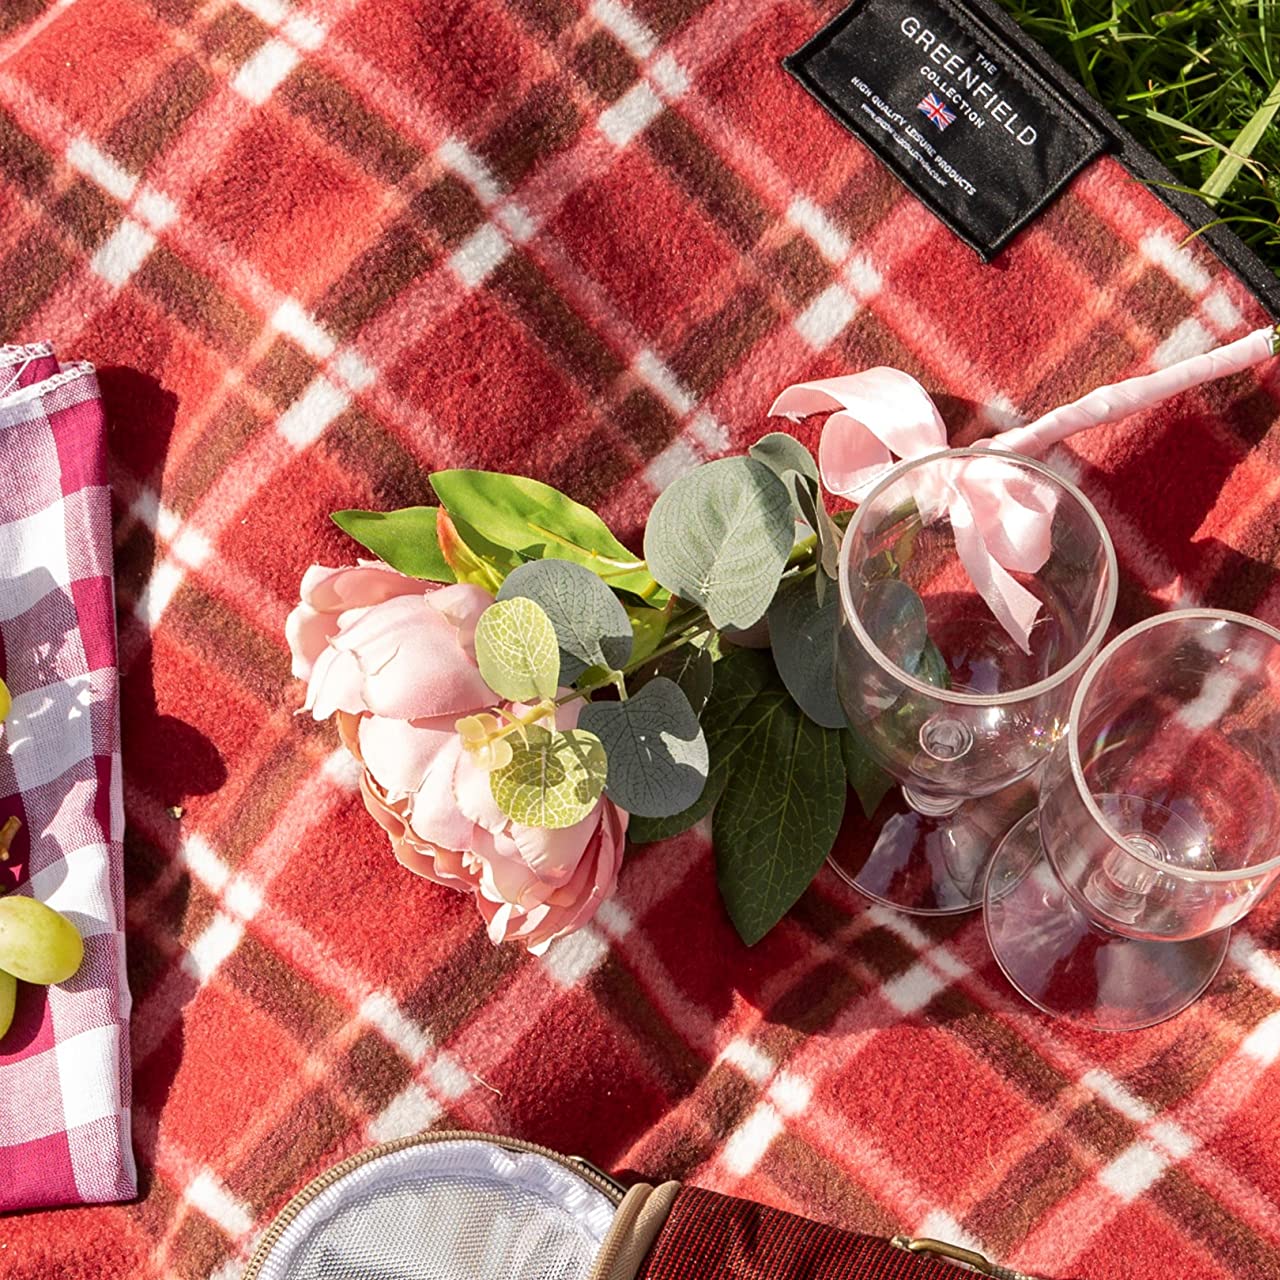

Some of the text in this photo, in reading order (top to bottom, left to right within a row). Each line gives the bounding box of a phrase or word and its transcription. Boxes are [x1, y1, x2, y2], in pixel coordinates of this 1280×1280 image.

[900, 16, 1038, 147] GREENFIELD
[920, 65, 986, 130] COLLECTION
[975, 53, 998, 75] THE
[850, 76, 977, 196] HIGH QUALITY LEISURE PRODUCTS
